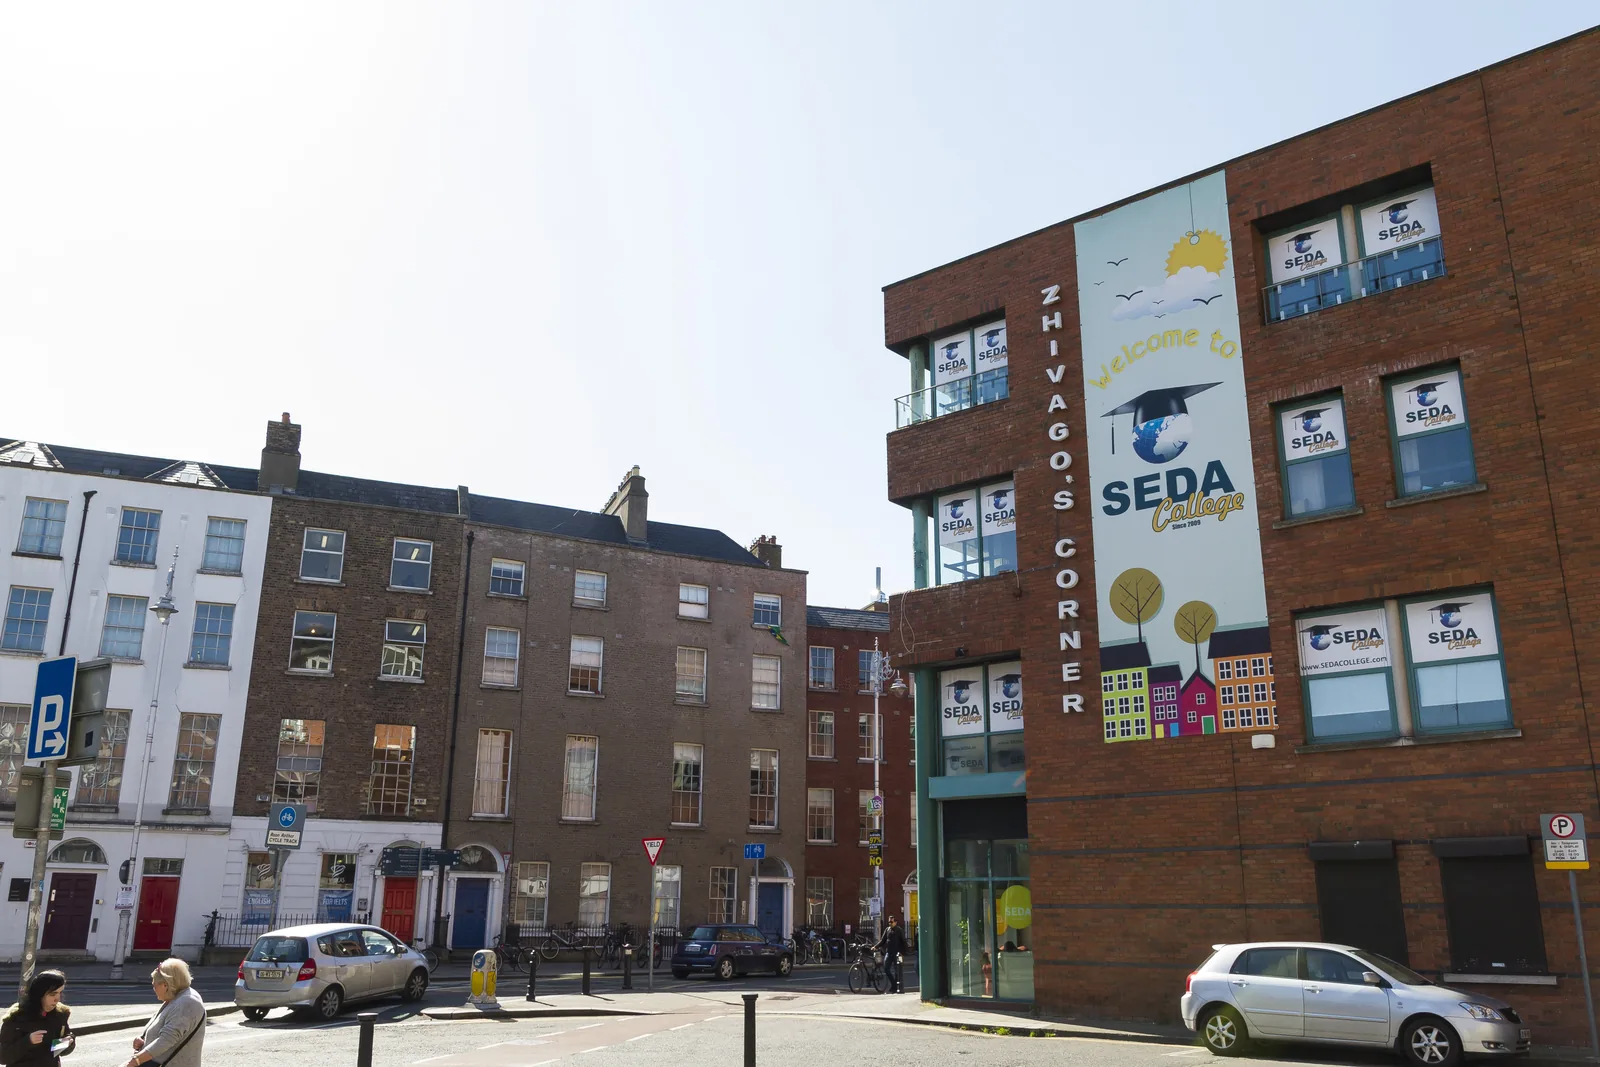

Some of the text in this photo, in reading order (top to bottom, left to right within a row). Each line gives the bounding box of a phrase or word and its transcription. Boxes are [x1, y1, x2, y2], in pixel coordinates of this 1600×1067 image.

[1378, 220, 1423, 240] SEDA
[1395, 228, 1426, 243] College
[1284, 250, 1326, 270] SEDA
[1300, 257, 1328, 272] College
[978, 345, 1008, 361] SEDA
[1088, 328, 1237, 390] Welcome to
[938, 358, 967, 373] SEDA
[1405, 404, 1453, 423] SEDA
[1424, 413, 1456, 427] College
[1291, 431, 1336, 449] SEDA
[1309, 439, 1339, 453] College
[1102, 459, 1236, 516] SEDA
[1041, 284, 1085, 713] ZHIVAGO'S CORNER
[984, 508, 1016, 523] SEDA
[1152, 491, 1245, 533] College
[942, 517, 972, 532] SEDA
[1171, 519, 1202, 530] Since 2009
[1332, 628, 1382, 644] SEDA
[1428, 627, 1478, 644] SEDA
[1351, 638, 1385, 651] College
[1447, 638, 1482, 651] College
[1300, 655, 1388, 671] www.SEDACOLLEGE.com
[943, 704, 980, 719] SEDA
[992, 700, 1023, 714] SED
[34, 694, 64, 753] P
[960, 759, 984, 768] SEDA
[871, 801, 882, 809] Yes
[1557, 819, 1568, 834] P
[870, 837, 882, 845] 97%
[870, 857, 882, 866] NO
[334, 898, 348, 906] IELTS
[1005, 907, 1032, 916] SEDA
